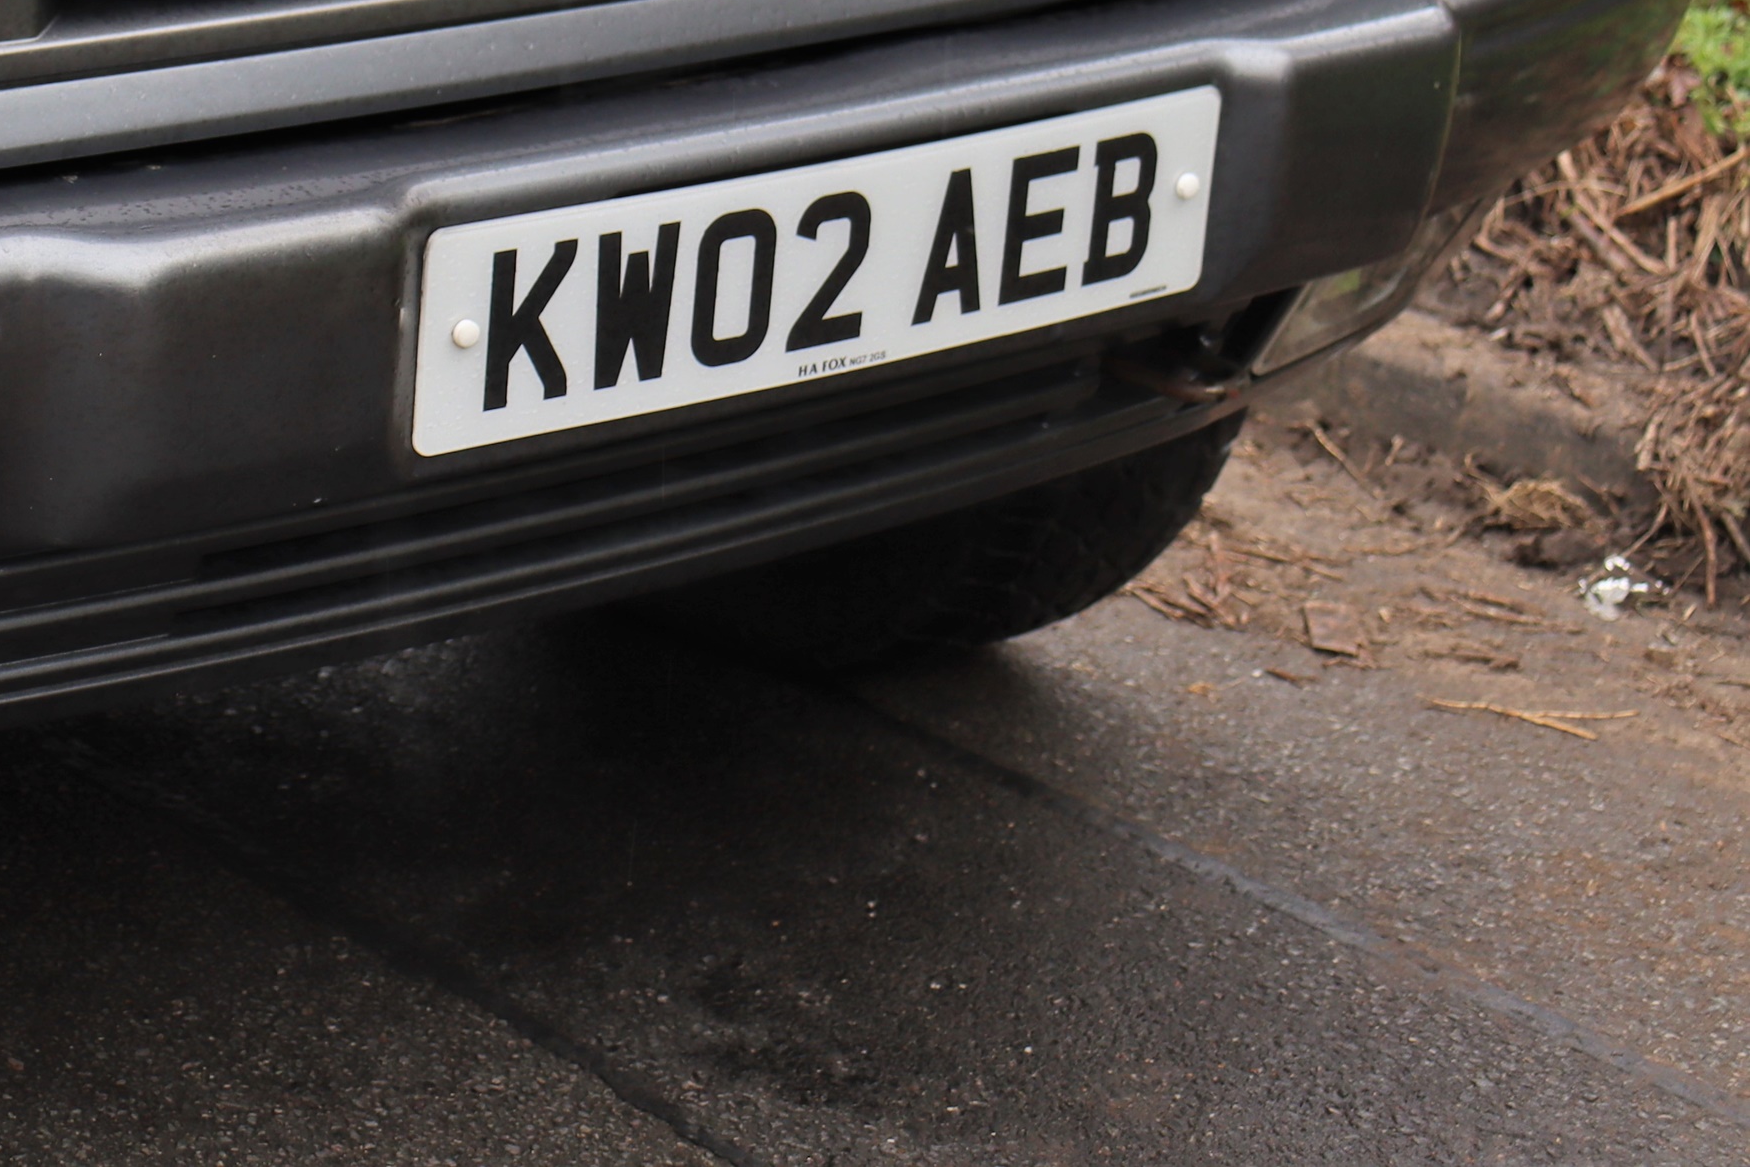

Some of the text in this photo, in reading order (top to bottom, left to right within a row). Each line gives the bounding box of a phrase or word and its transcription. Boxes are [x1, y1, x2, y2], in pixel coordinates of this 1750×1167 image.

[483, 132, 1158, 411] KW02 AEB
[822, 356, 848, 373] FOX
